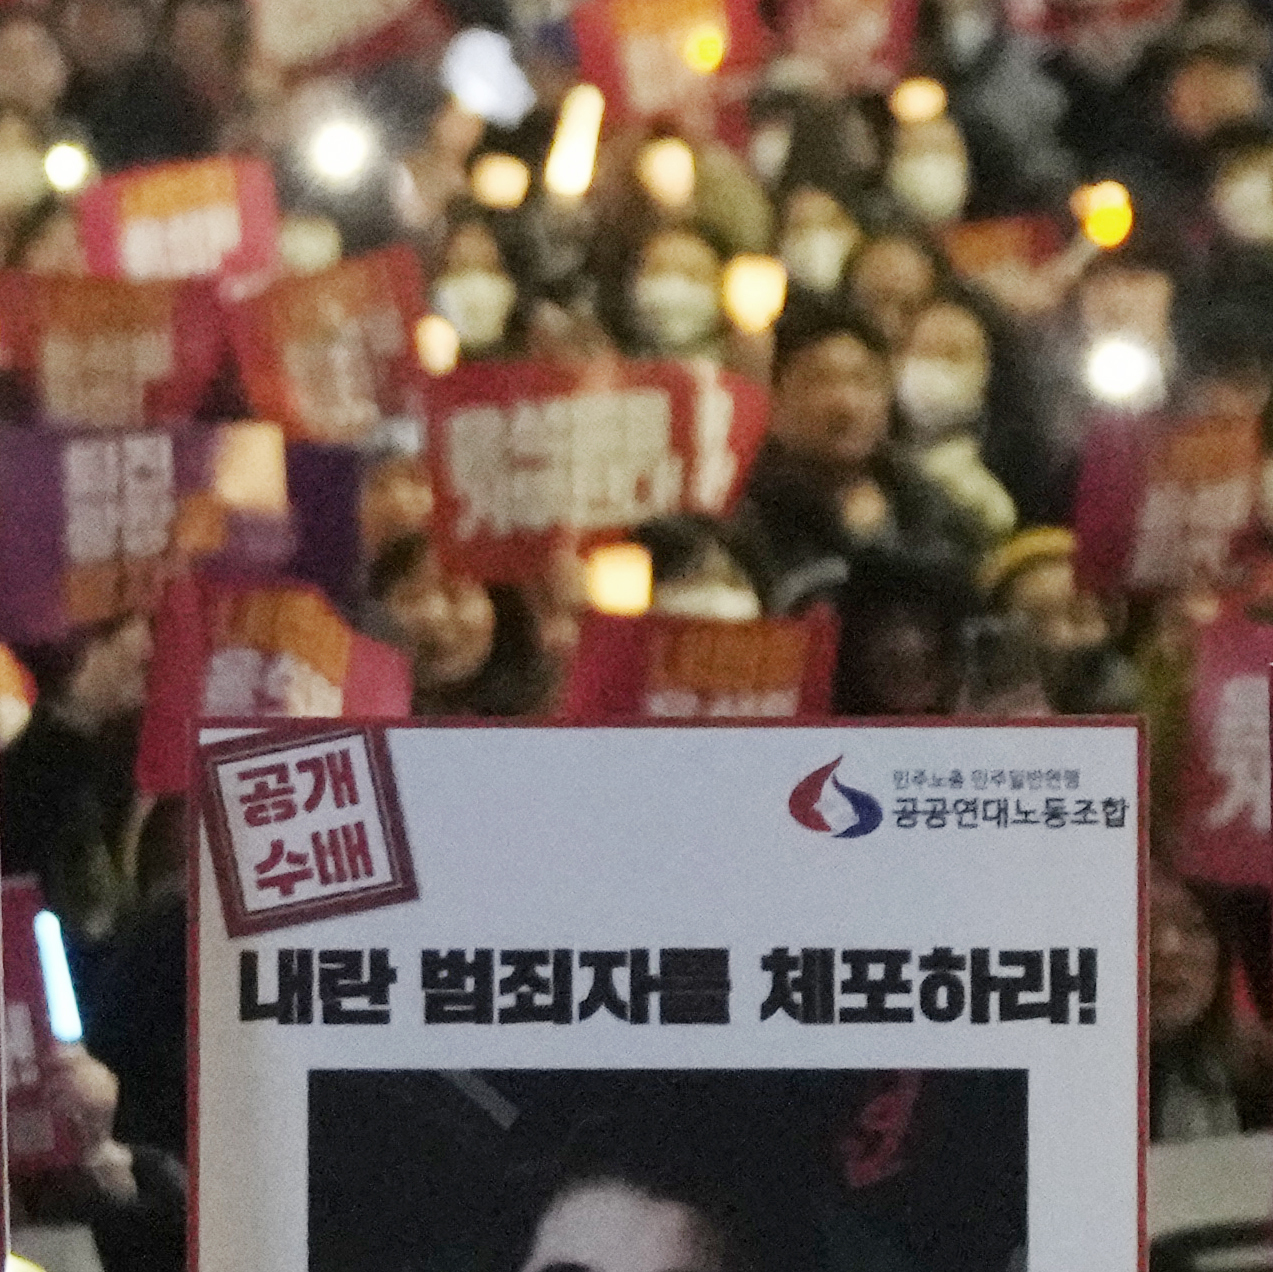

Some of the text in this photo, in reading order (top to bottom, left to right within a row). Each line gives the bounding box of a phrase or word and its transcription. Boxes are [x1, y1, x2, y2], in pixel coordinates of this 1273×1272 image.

[237, 749, 360, 827] 공개
[892, 796, 1129, 830] 공공연대노동조합
[254, 821, 374, 896] 수배
[238, 946, 1098, 1027] 내란 범죄자를 체포하라!
